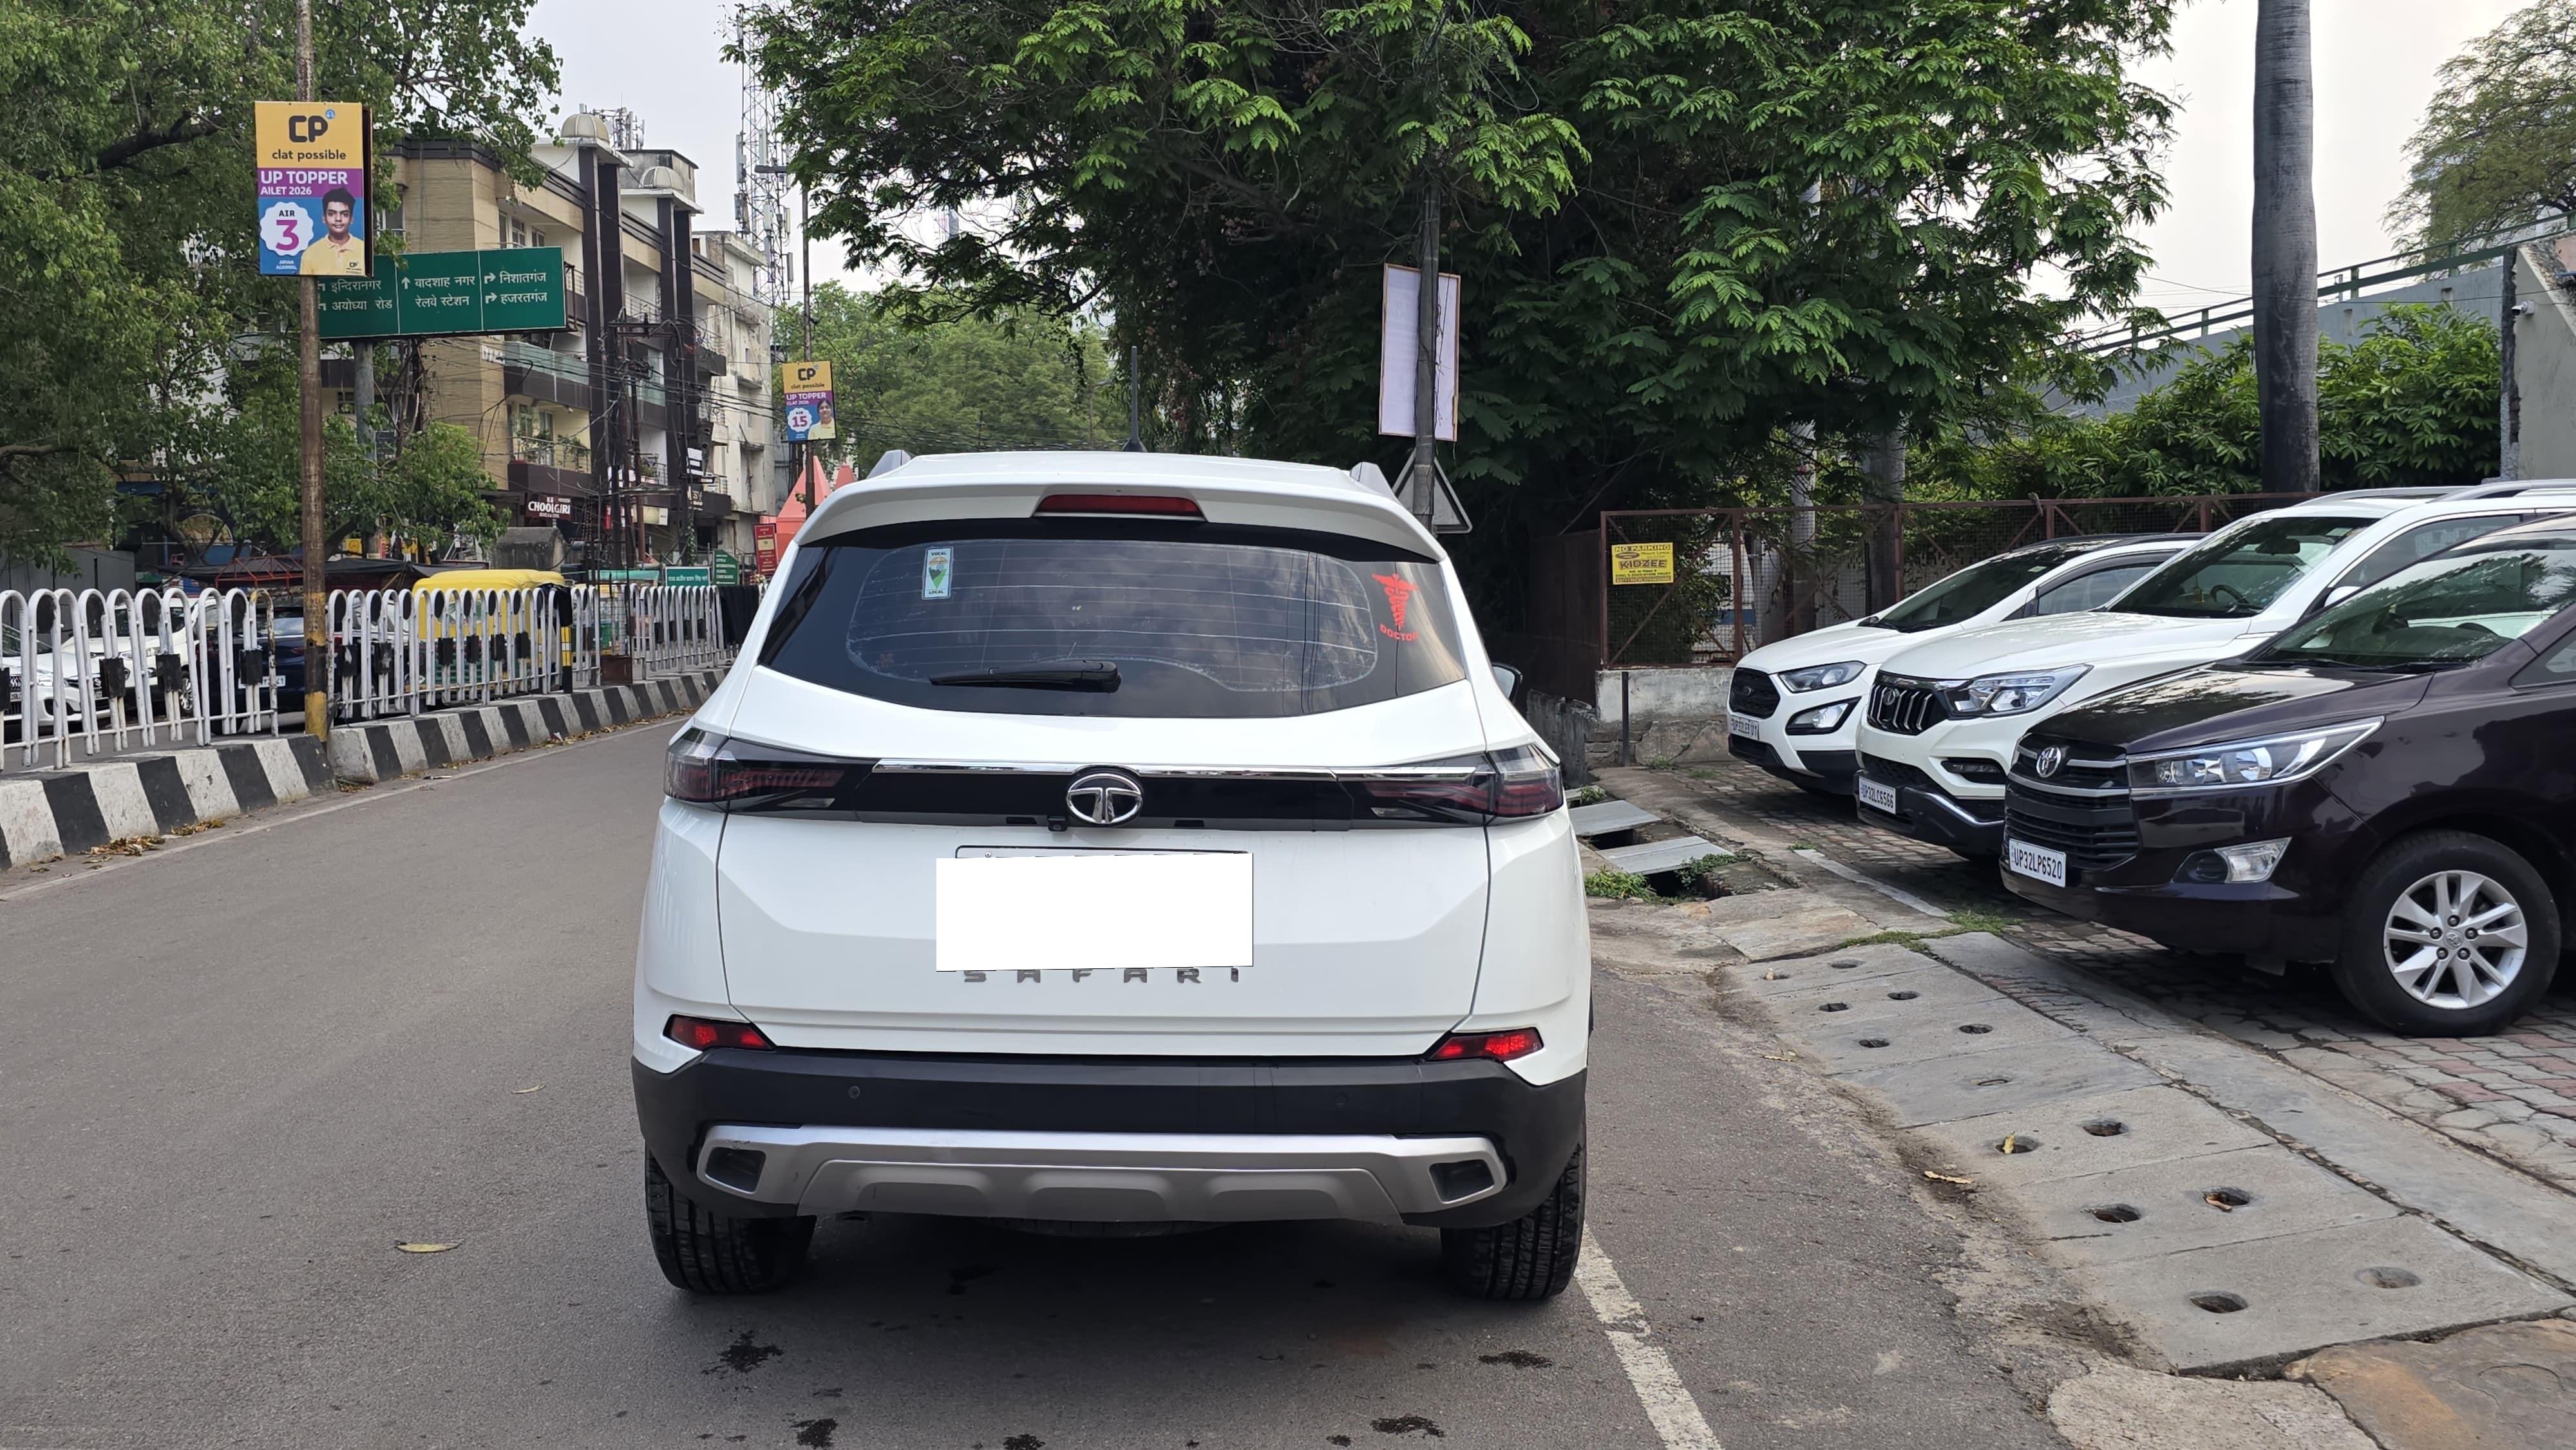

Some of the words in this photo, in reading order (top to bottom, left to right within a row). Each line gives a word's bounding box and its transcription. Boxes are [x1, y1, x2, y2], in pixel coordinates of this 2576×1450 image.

[289, 115, 328, 143] CP
[272, 149, 294, 160] clat
[297, 149, 346, 162] possible
[260, 171, 283, 184] UP
[286, 171, 348, 185] TOPPER
[260, 187, 287, 195] AILET
[289, 187, 312, 195] 2026
[276, 220, 299, 251] 3
[414, 277, 451, 288] बादशाह
[453, 276, 475, 286] नगर
[500, 269, 547, 284] निशातगंज
[330, 278, 382, 293] इन्दिरानगर
[375, 296, 393, 309] रोड
[415, 294, 437, 307] रेलवे
[440, 293, 469, 306] स्टेशन
[500, 288, 547, 305] हजरतगंज
[798, 368, 816, 381] CP
[792, 415, 808, 428] 15
[1618, 560, 1667, 569] KIDZEE
[1379, 623, 1419, 641] DOCTOR
[2014, 847, 2063, 880] UP32LP6520
[963, 968, 1240, 984] SAFARI
